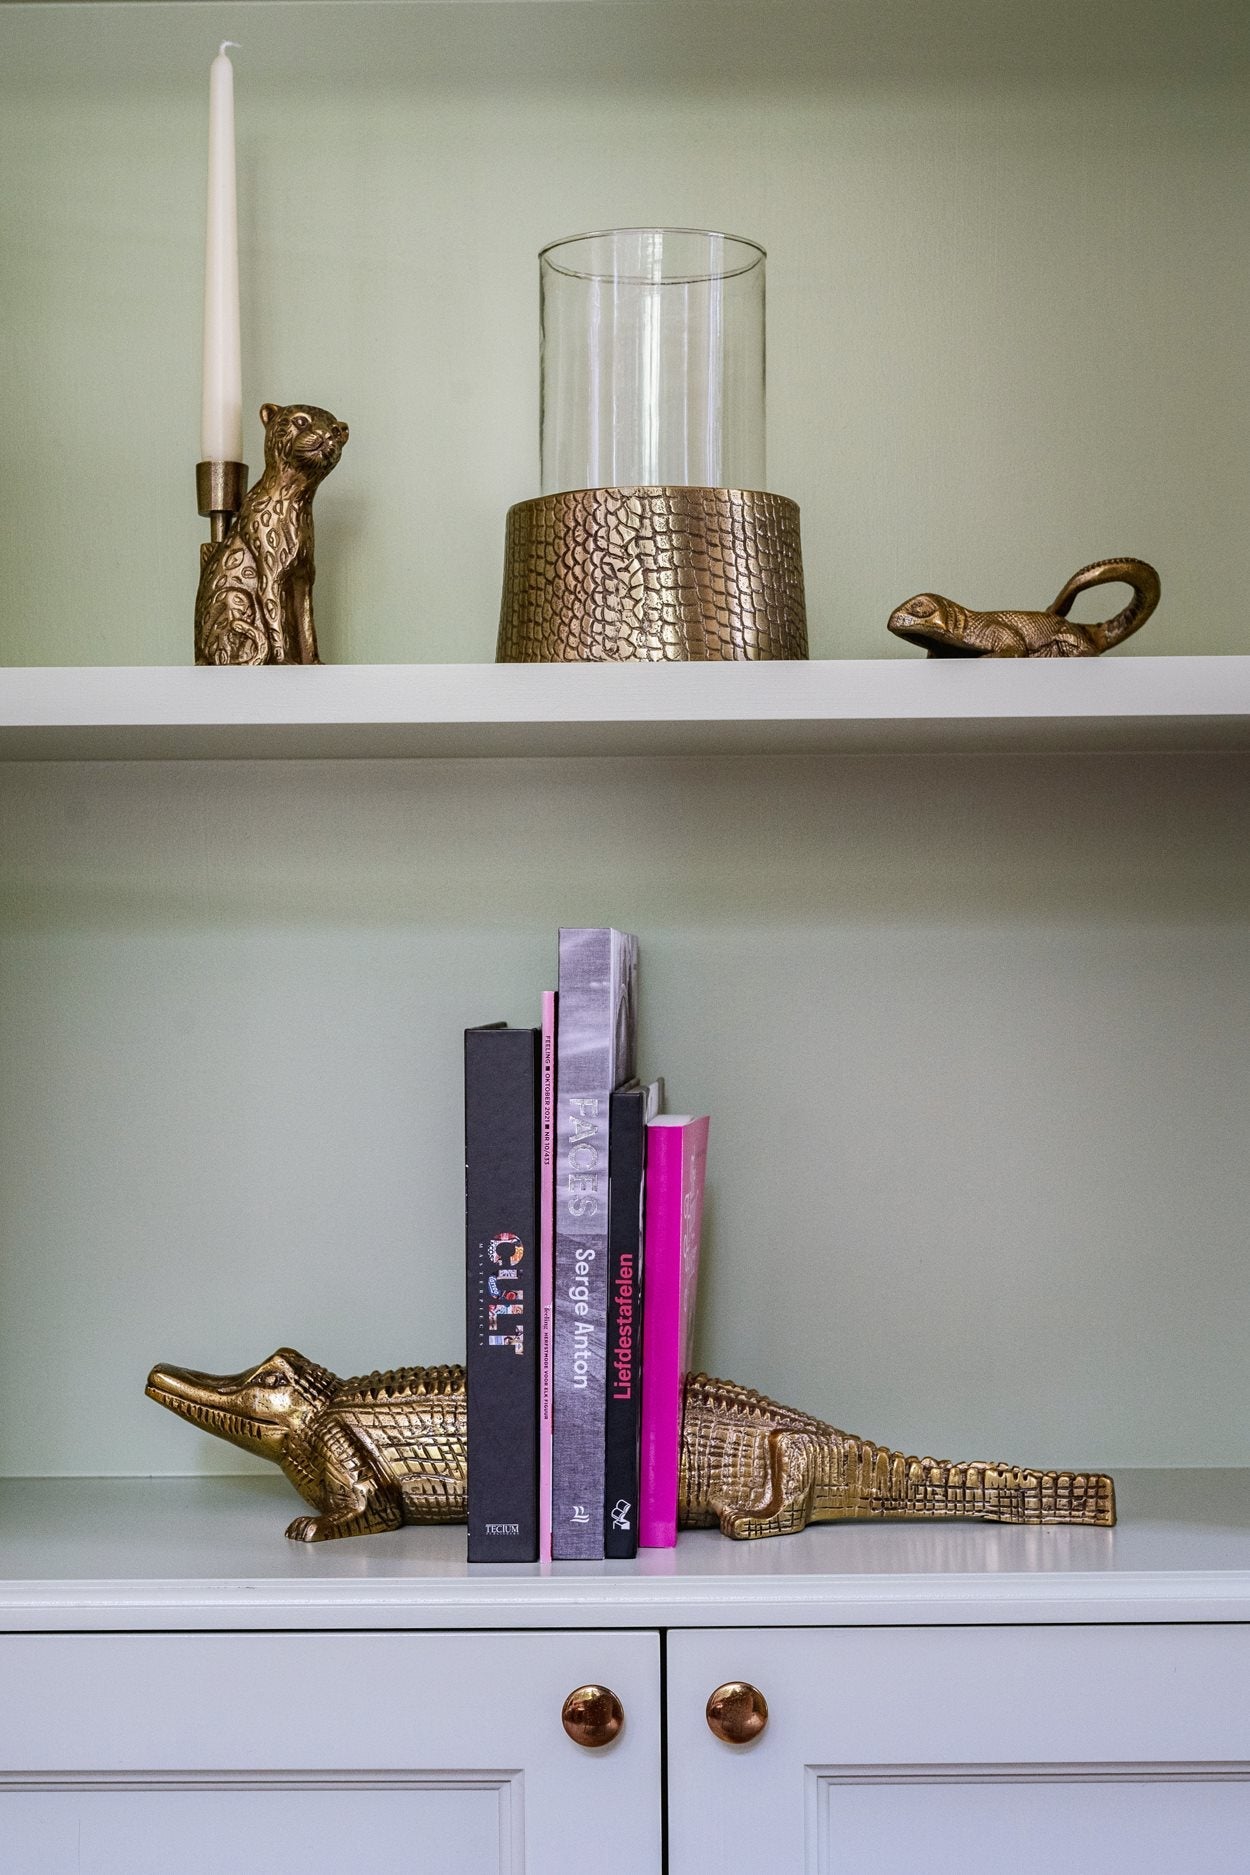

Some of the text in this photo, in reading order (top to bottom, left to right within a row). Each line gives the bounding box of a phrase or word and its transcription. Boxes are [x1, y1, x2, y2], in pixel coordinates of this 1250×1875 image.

[544, 1131, 550, 1141] NR
[568, 1098, 599, 1217] FACES
[488, 1232, 524, 1355] CULT
[569, 1249, 596, 1389] Serge Anton
[613, 1253, 634, 1400] Liefdestafelen
